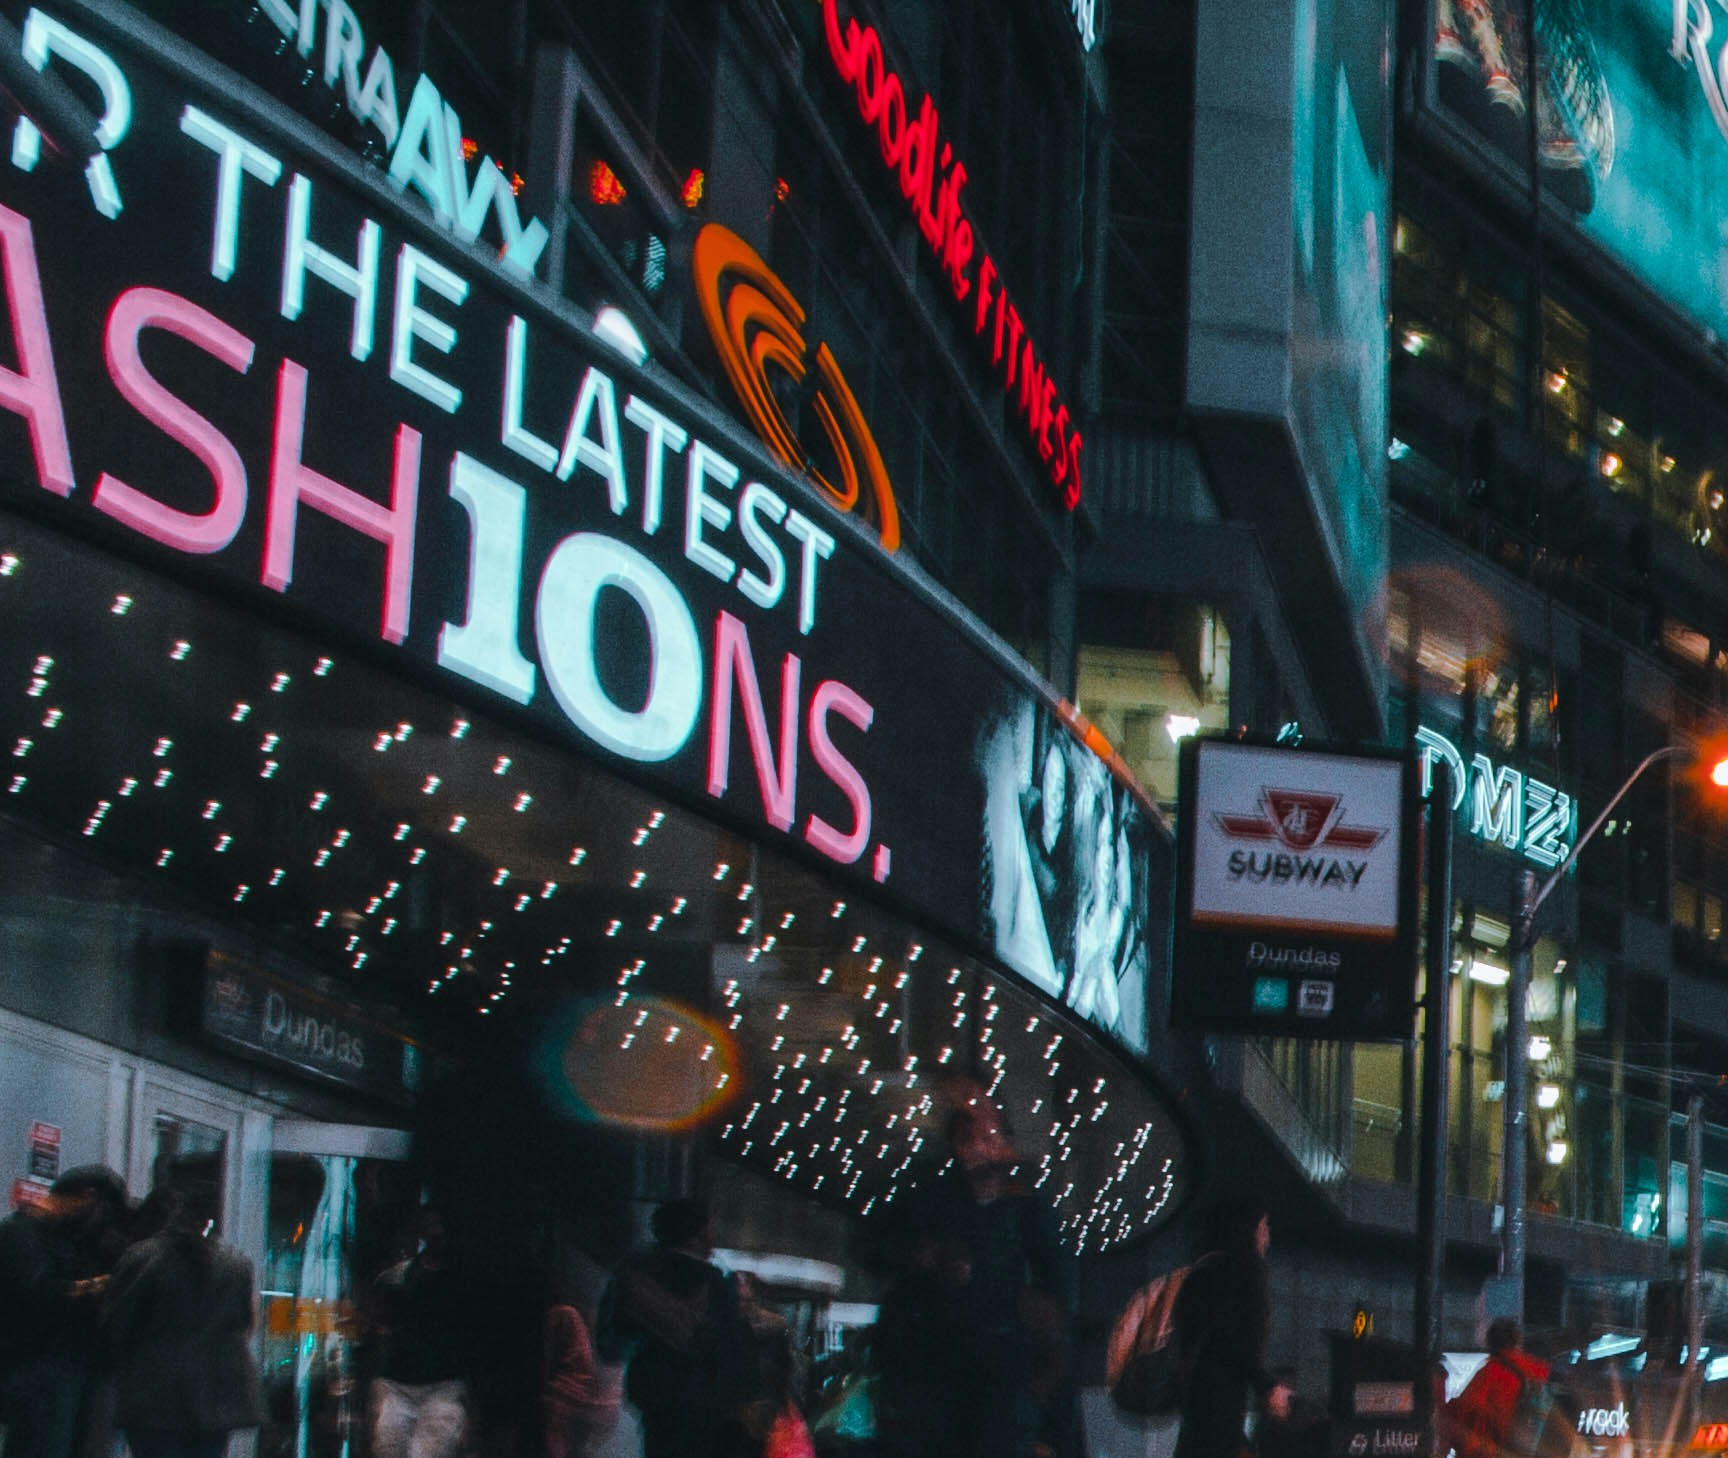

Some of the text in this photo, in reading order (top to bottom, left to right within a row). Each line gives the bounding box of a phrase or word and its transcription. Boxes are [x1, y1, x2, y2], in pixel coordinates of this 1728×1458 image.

[180, 104, 469, 414] THE
[502, 315, 835, 634] LATEST
[974, 255, 1082, 511] FITNESS
[1414, 724, 1573, 868] DMZ
[1227, 849, 1368, 888] SUBWAY
[1248, 941, 1341, 968] Dundas
[263, 991, 365, 1069] Dundas
[1374, 1429, 1420, 1451] Litter
